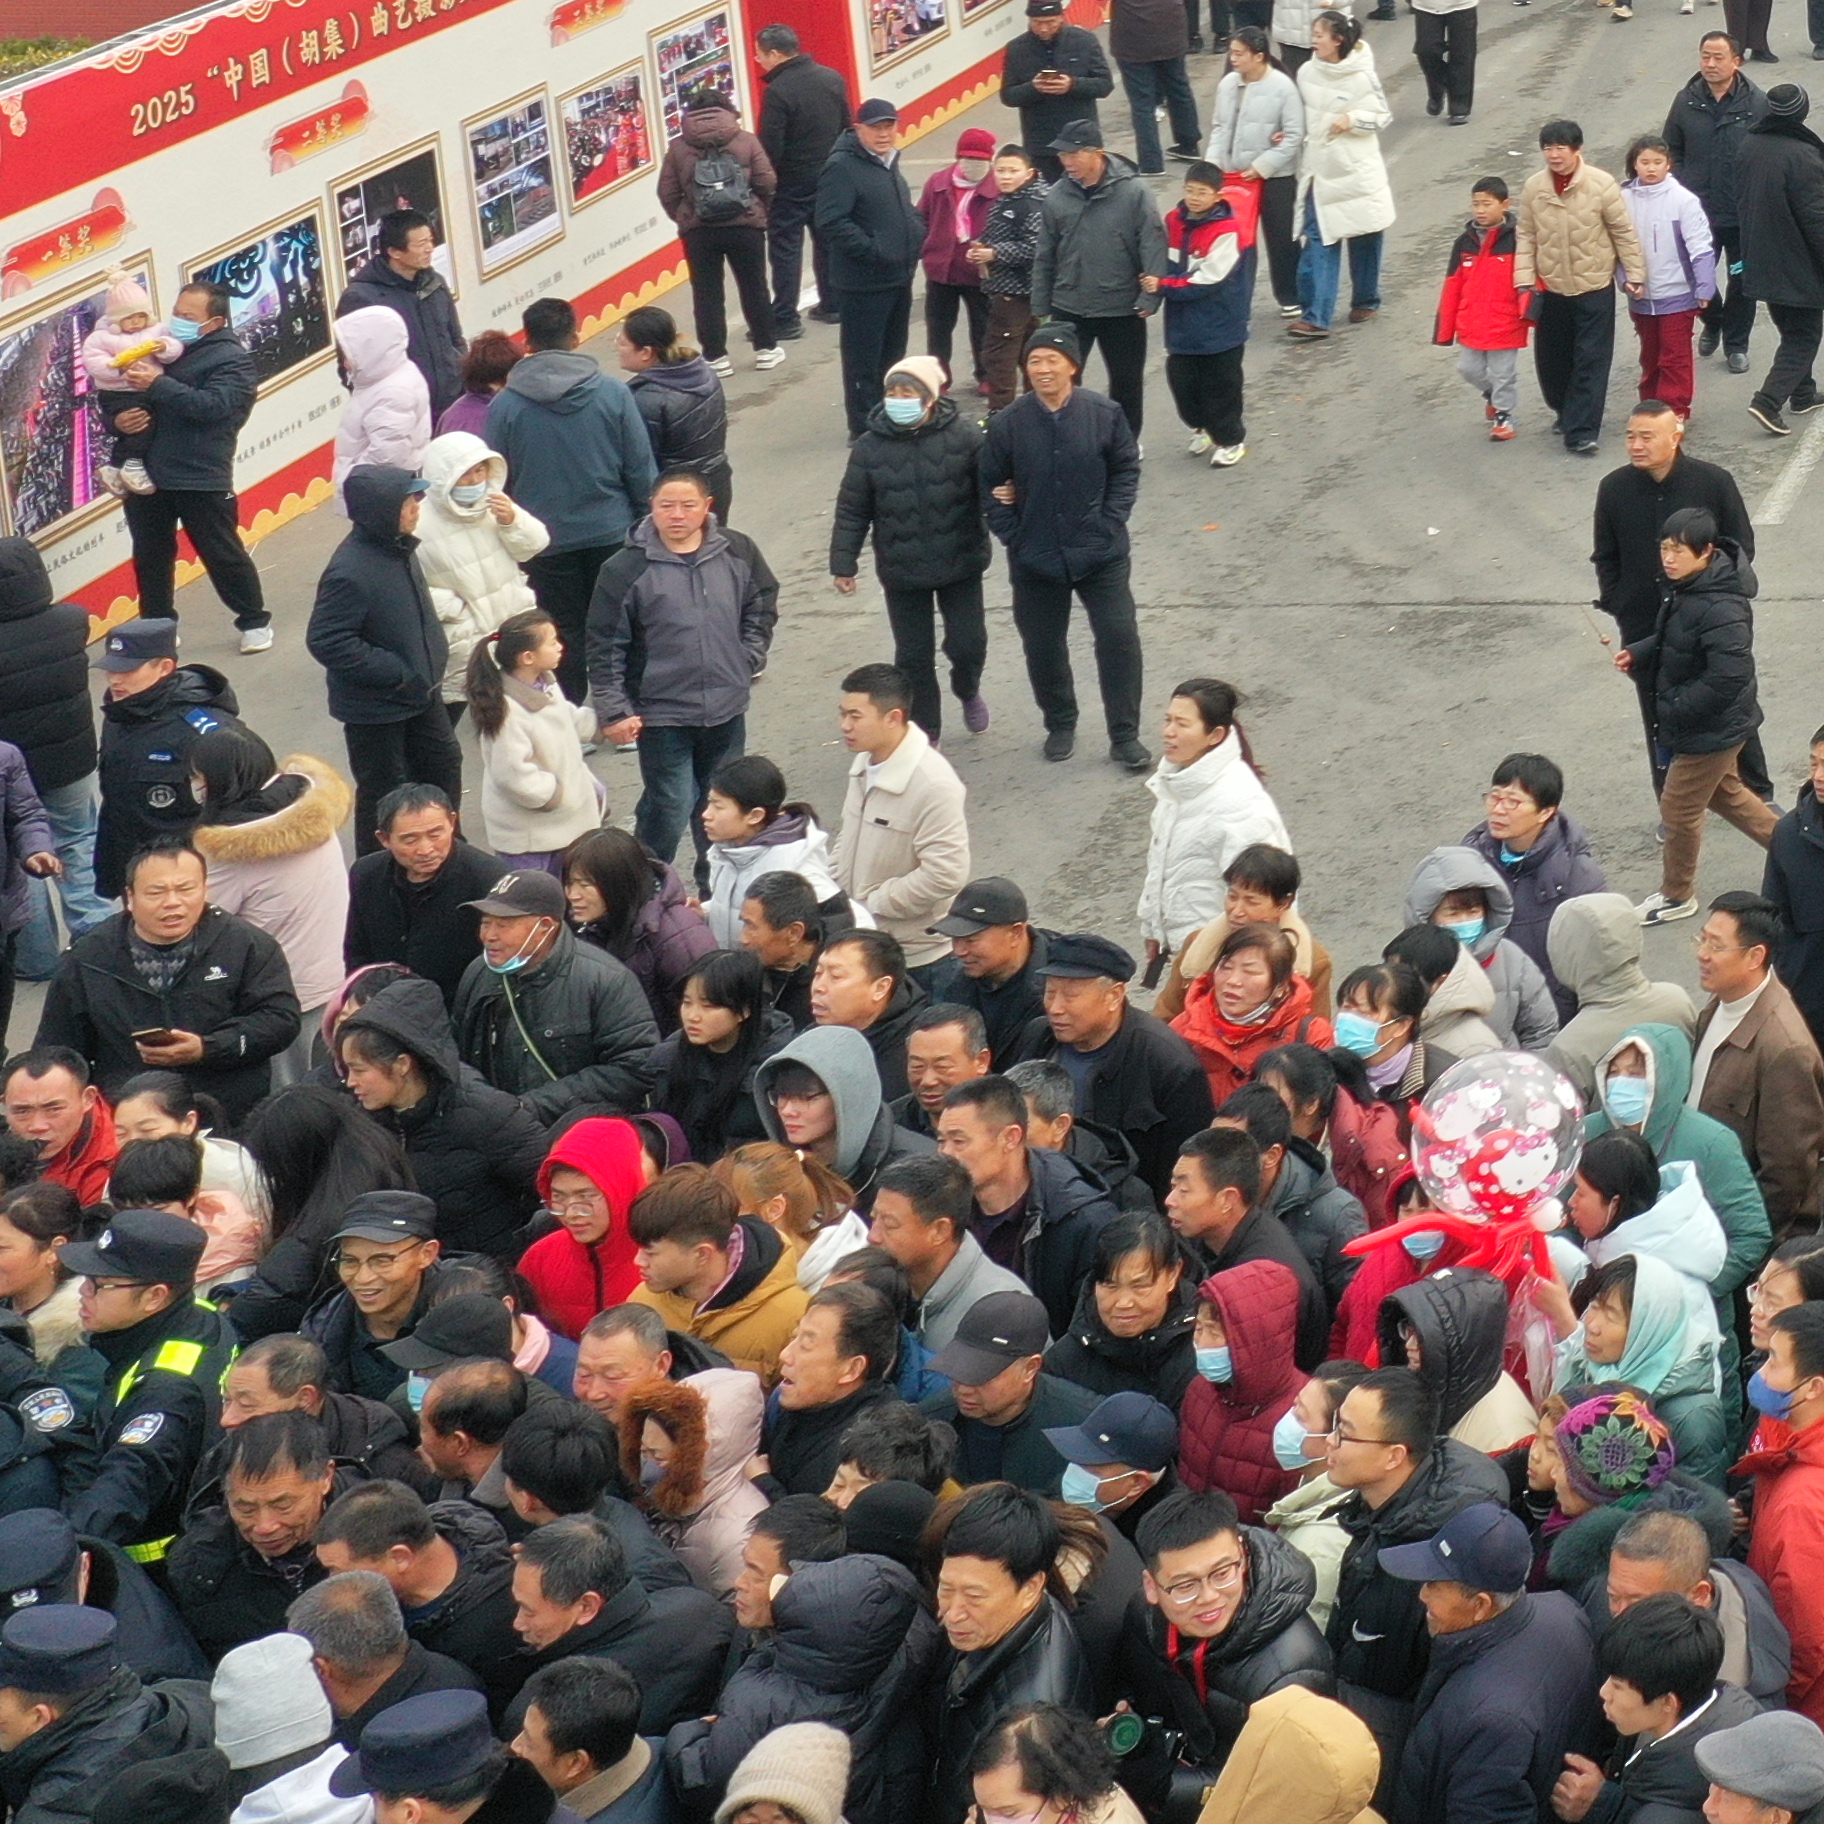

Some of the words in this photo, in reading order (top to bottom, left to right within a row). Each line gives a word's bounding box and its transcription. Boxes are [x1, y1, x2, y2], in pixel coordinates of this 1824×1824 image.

[130, 83, 196, 137] 2025
[300, 113, 346, 149] 二等奖
[41, 225, 95, 264] 一等奖
